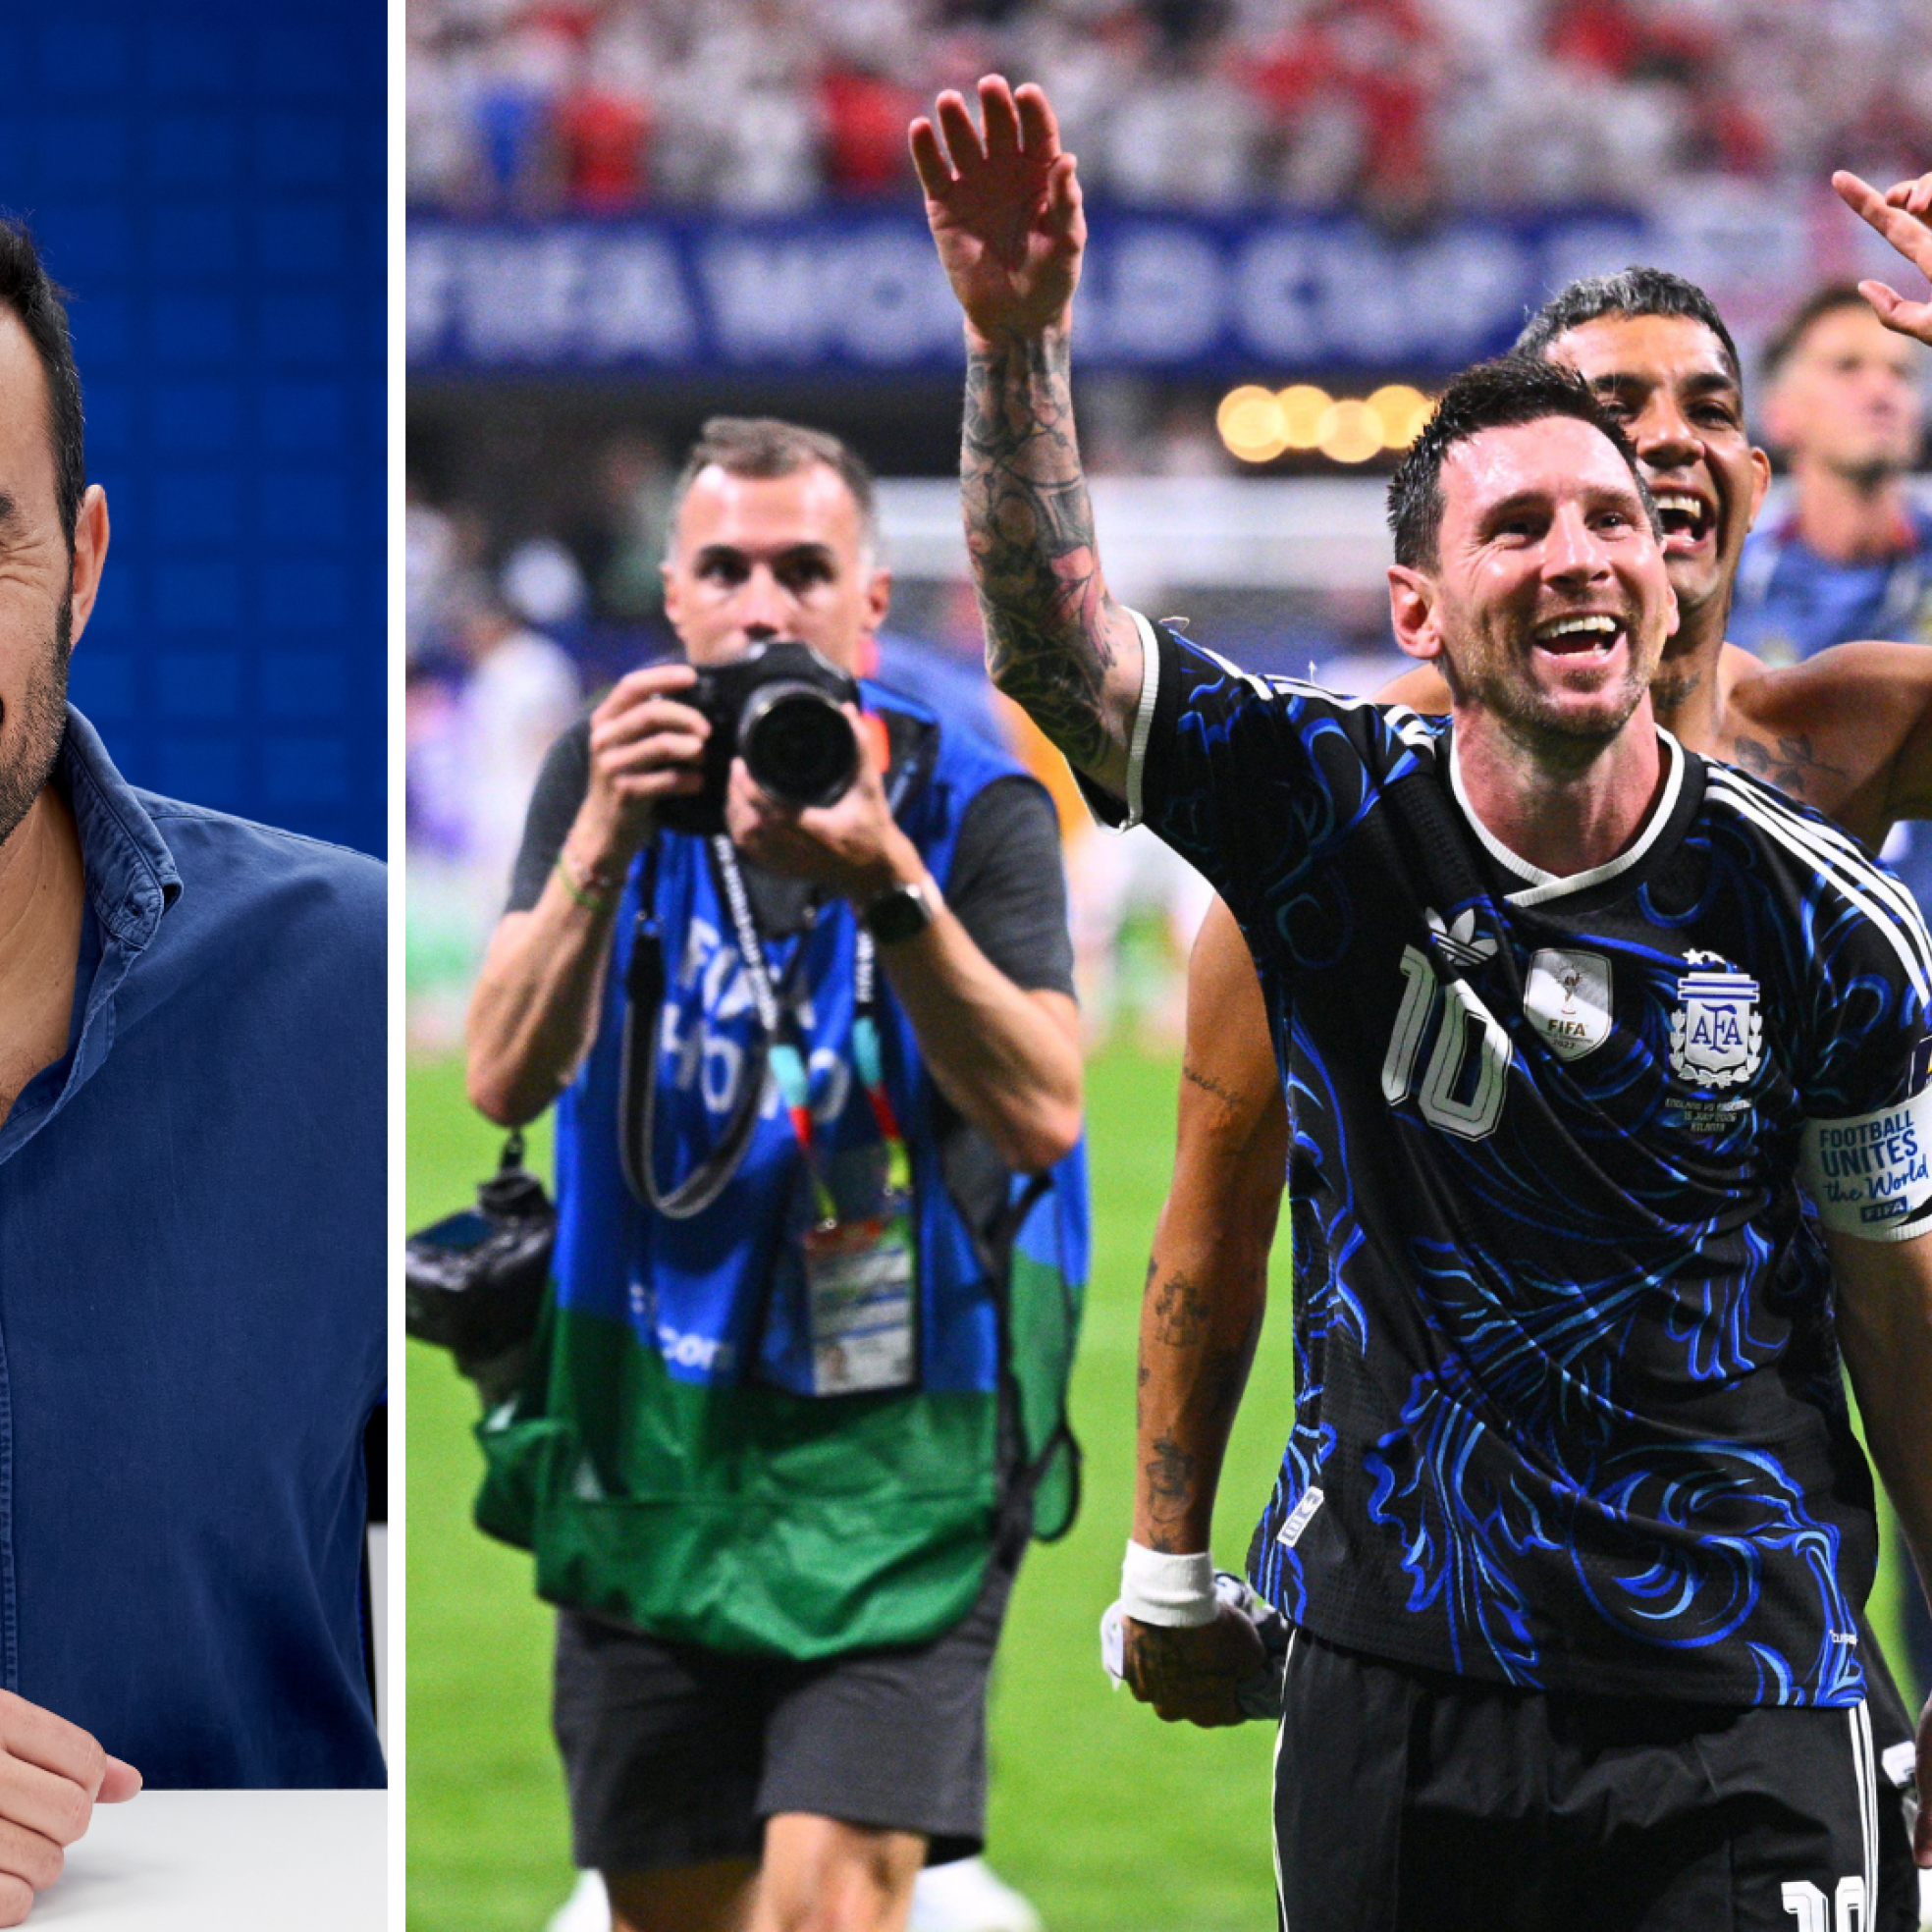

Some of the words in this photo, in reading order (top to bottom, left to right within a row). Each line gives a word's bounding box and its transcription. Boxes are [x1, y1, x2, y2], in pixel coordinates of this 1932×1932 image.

[699, 218, 1227, 365] WOD
[1381, 943, 1514, 1142] 10
[1547, 1019, 1586, 1037] FIFA
[1690, 1002, 1744, 1054] AFA
[1819, 1109, 1914, 1148] FOOTBALL
[1821, 1129, 1918, 1177] UNITES
[1823, 1180, 1863, 1203] the
[1864, 1153, 1929, 1200] World
[1863, 1198, 1906, 1220] FIFA
